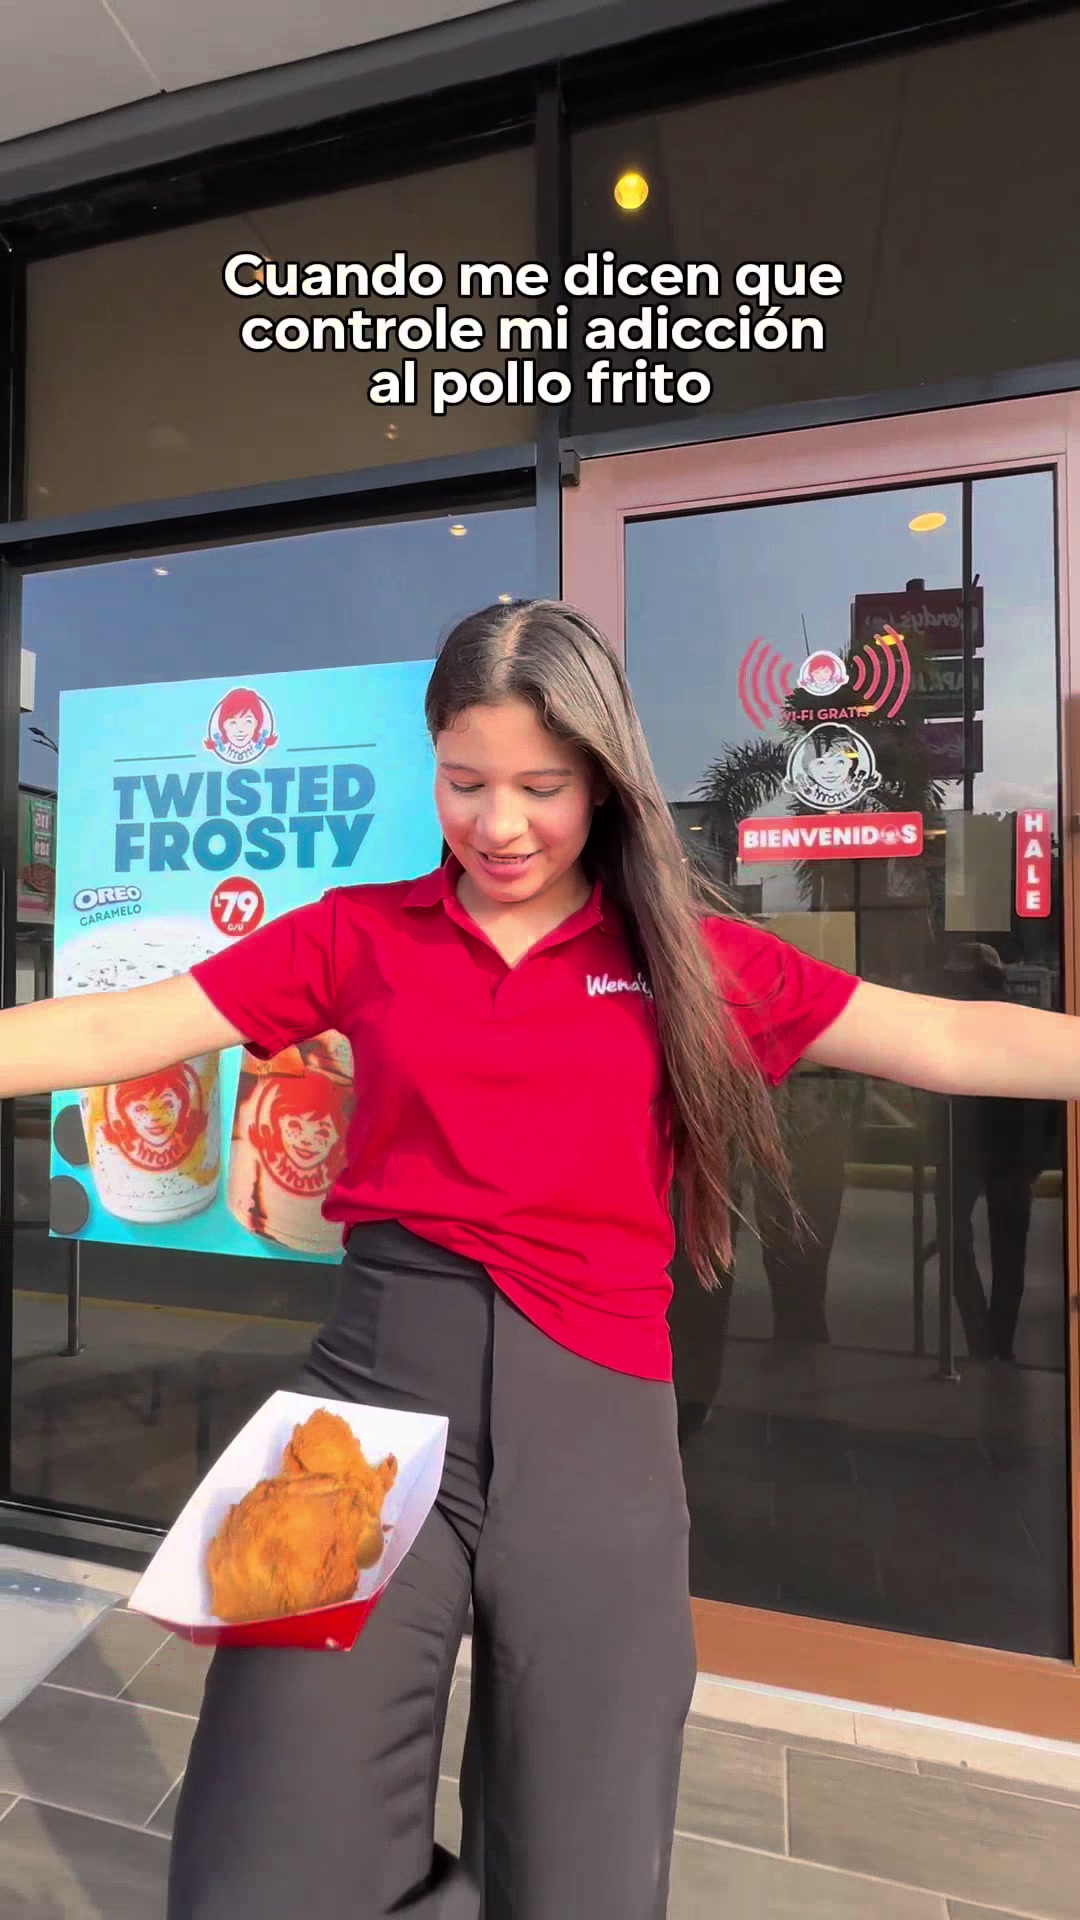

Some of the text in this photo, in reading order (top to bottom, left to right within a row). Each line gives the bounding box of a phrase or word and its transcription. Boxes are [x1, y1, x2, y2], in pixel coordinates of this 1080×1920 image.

[113, 763, 377, 820] TWISTED
[114, 813, 375, 873] FROSTY
[1024, 812, 1044, 911] HALE
[74, 884, 142, 911] OREO
[79, 903, 142, 926] CARAMELO
[227, 923, 245, 933] C/U
